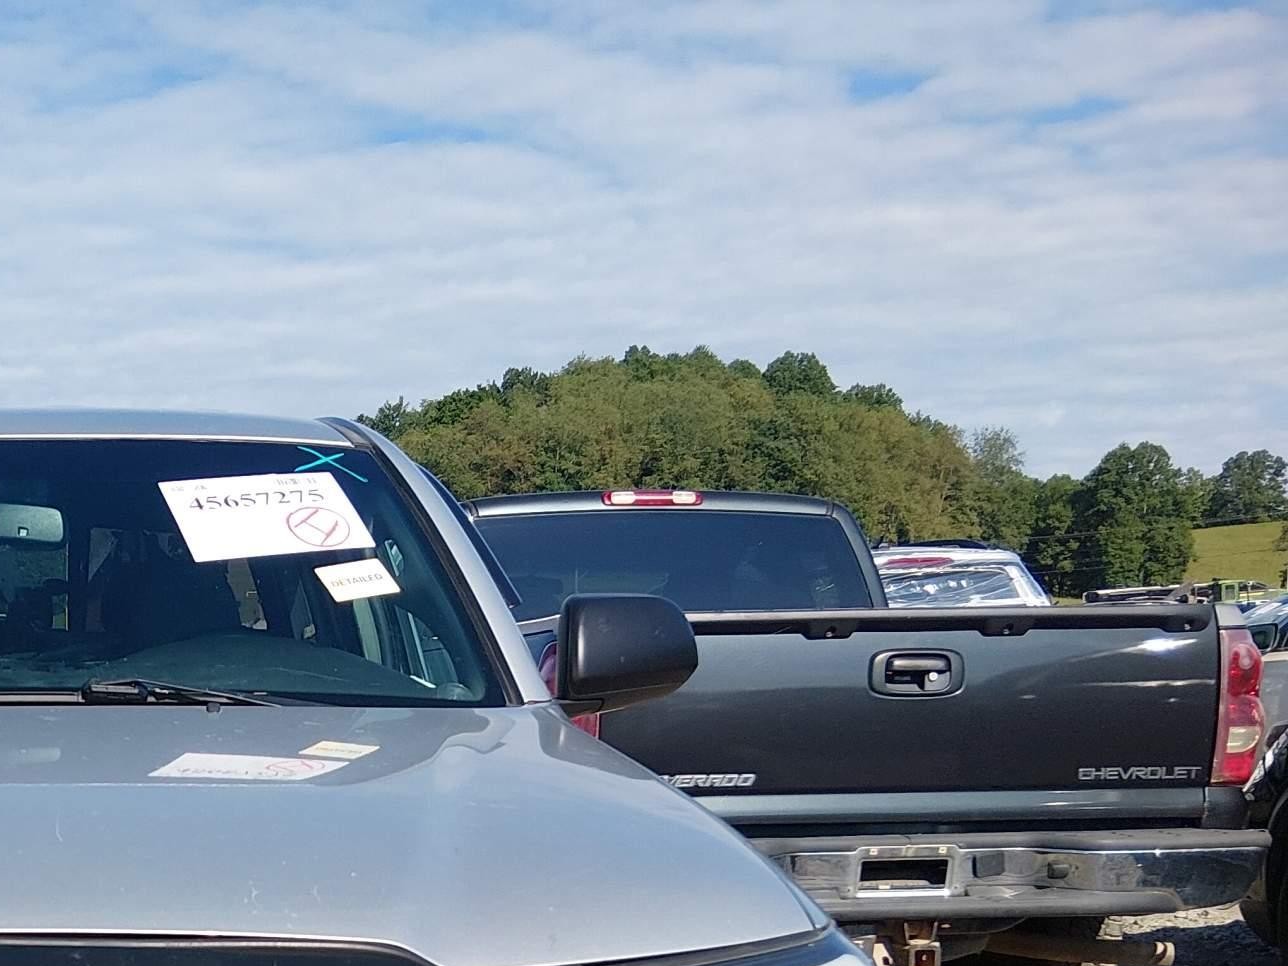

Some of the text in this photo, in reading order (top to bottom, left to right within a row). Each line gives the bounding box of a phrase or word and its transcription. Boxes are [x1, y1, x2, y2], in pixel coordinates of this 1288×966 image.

[189, 488, 325, 510] 45657275
[658, 773, 757, 788] VERADO
[1077, 766, 1203, 780] CHEVROLET
